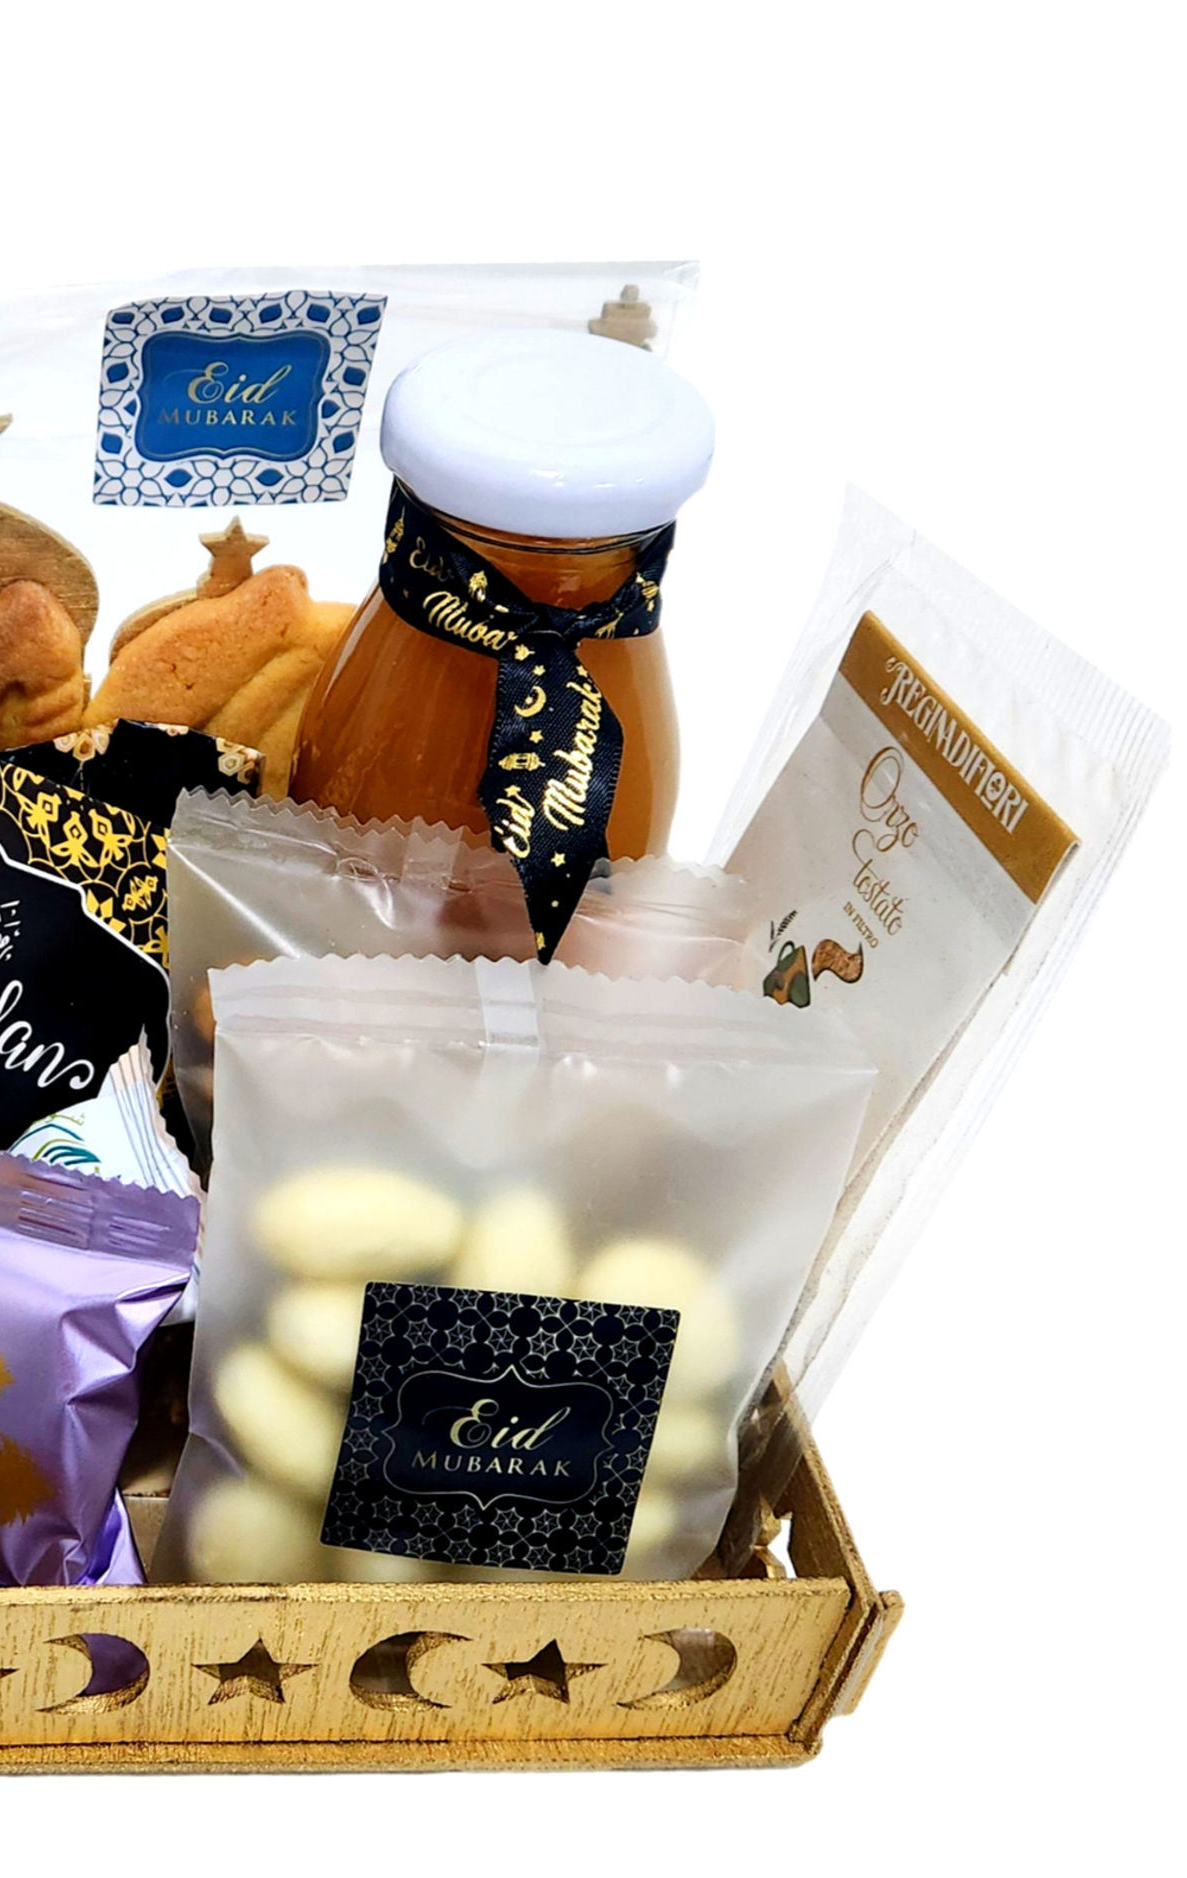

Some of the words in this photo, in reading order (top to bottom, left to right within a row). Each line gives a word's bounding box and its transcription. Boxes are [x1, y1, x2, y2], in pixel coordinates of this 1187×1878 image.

[166, 361, 292, 405] Eid
[157, 408, 297, 426] MUBARAK
[542, 681, 604, 831] Mubarak
[860, 746, 918, 852] Orzo
[493, 794, 537, 859] Eid
[422, 1398, 571, 1450] Eid
[412, 1450, 572, 1477] MUBARAK
